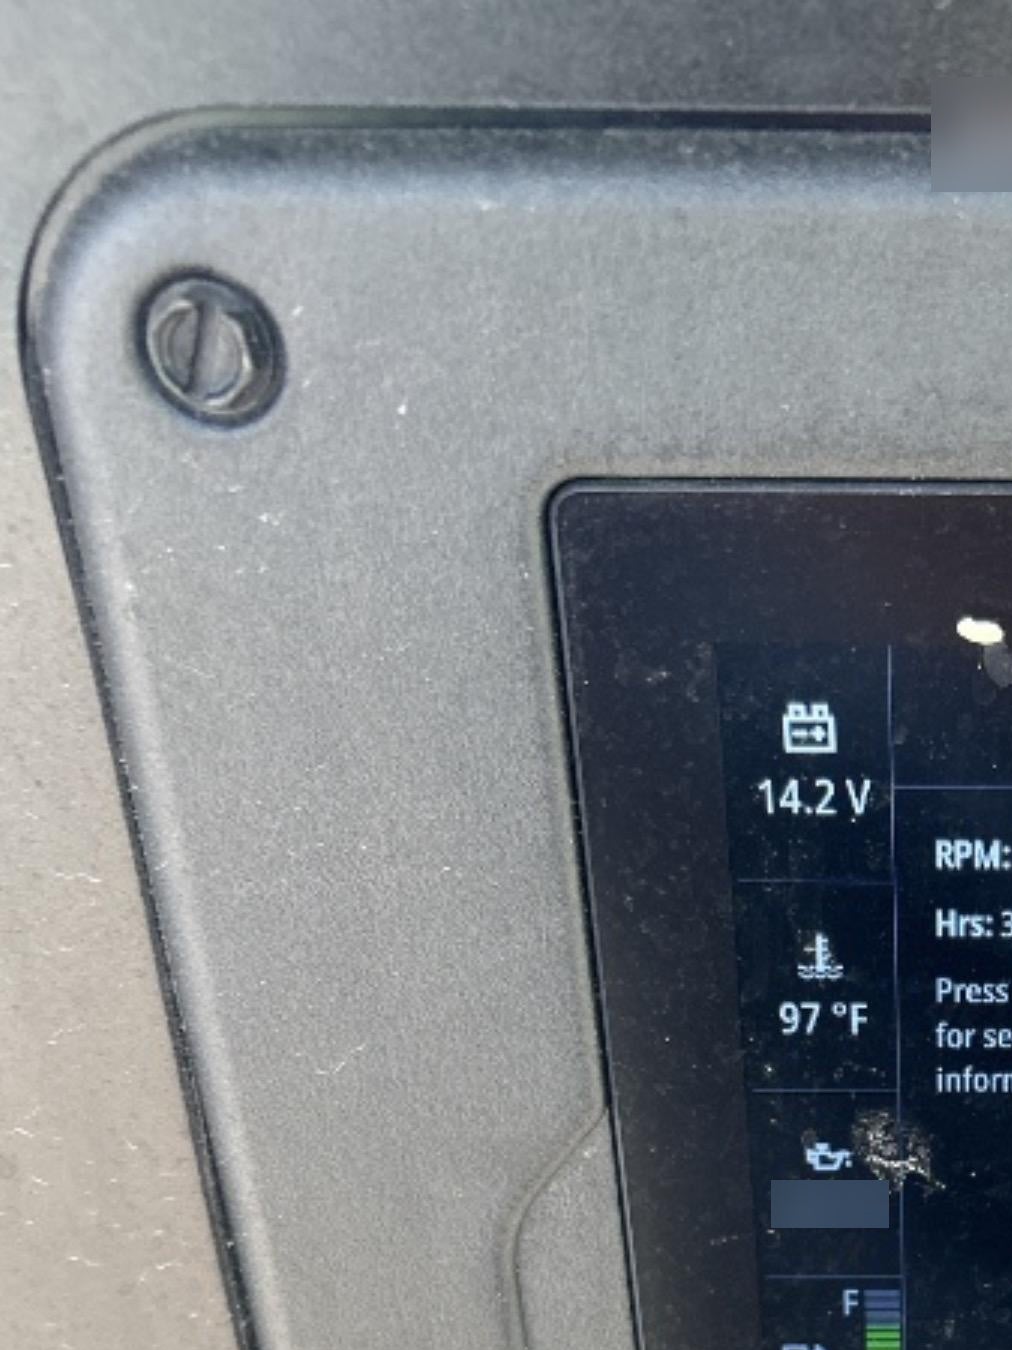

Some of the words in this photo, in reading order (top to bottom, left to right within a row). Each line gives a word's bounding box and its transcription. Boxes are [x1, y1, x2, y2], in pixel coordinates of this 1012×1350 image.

[758, 780, 838, 815] 14.2
[846, 780, 872, 815] V
[935, 840, 1012, 870] RPM:
[935, 908, 995, 939] Hrs:
[936, 978, 1009, 1003] Press
[779, 1003, 820, 1036] 97
[831, 1002, 868, 1036] °F
[936, 1022, 973, 1049] for
[842, 1289, 859, 1315] F
